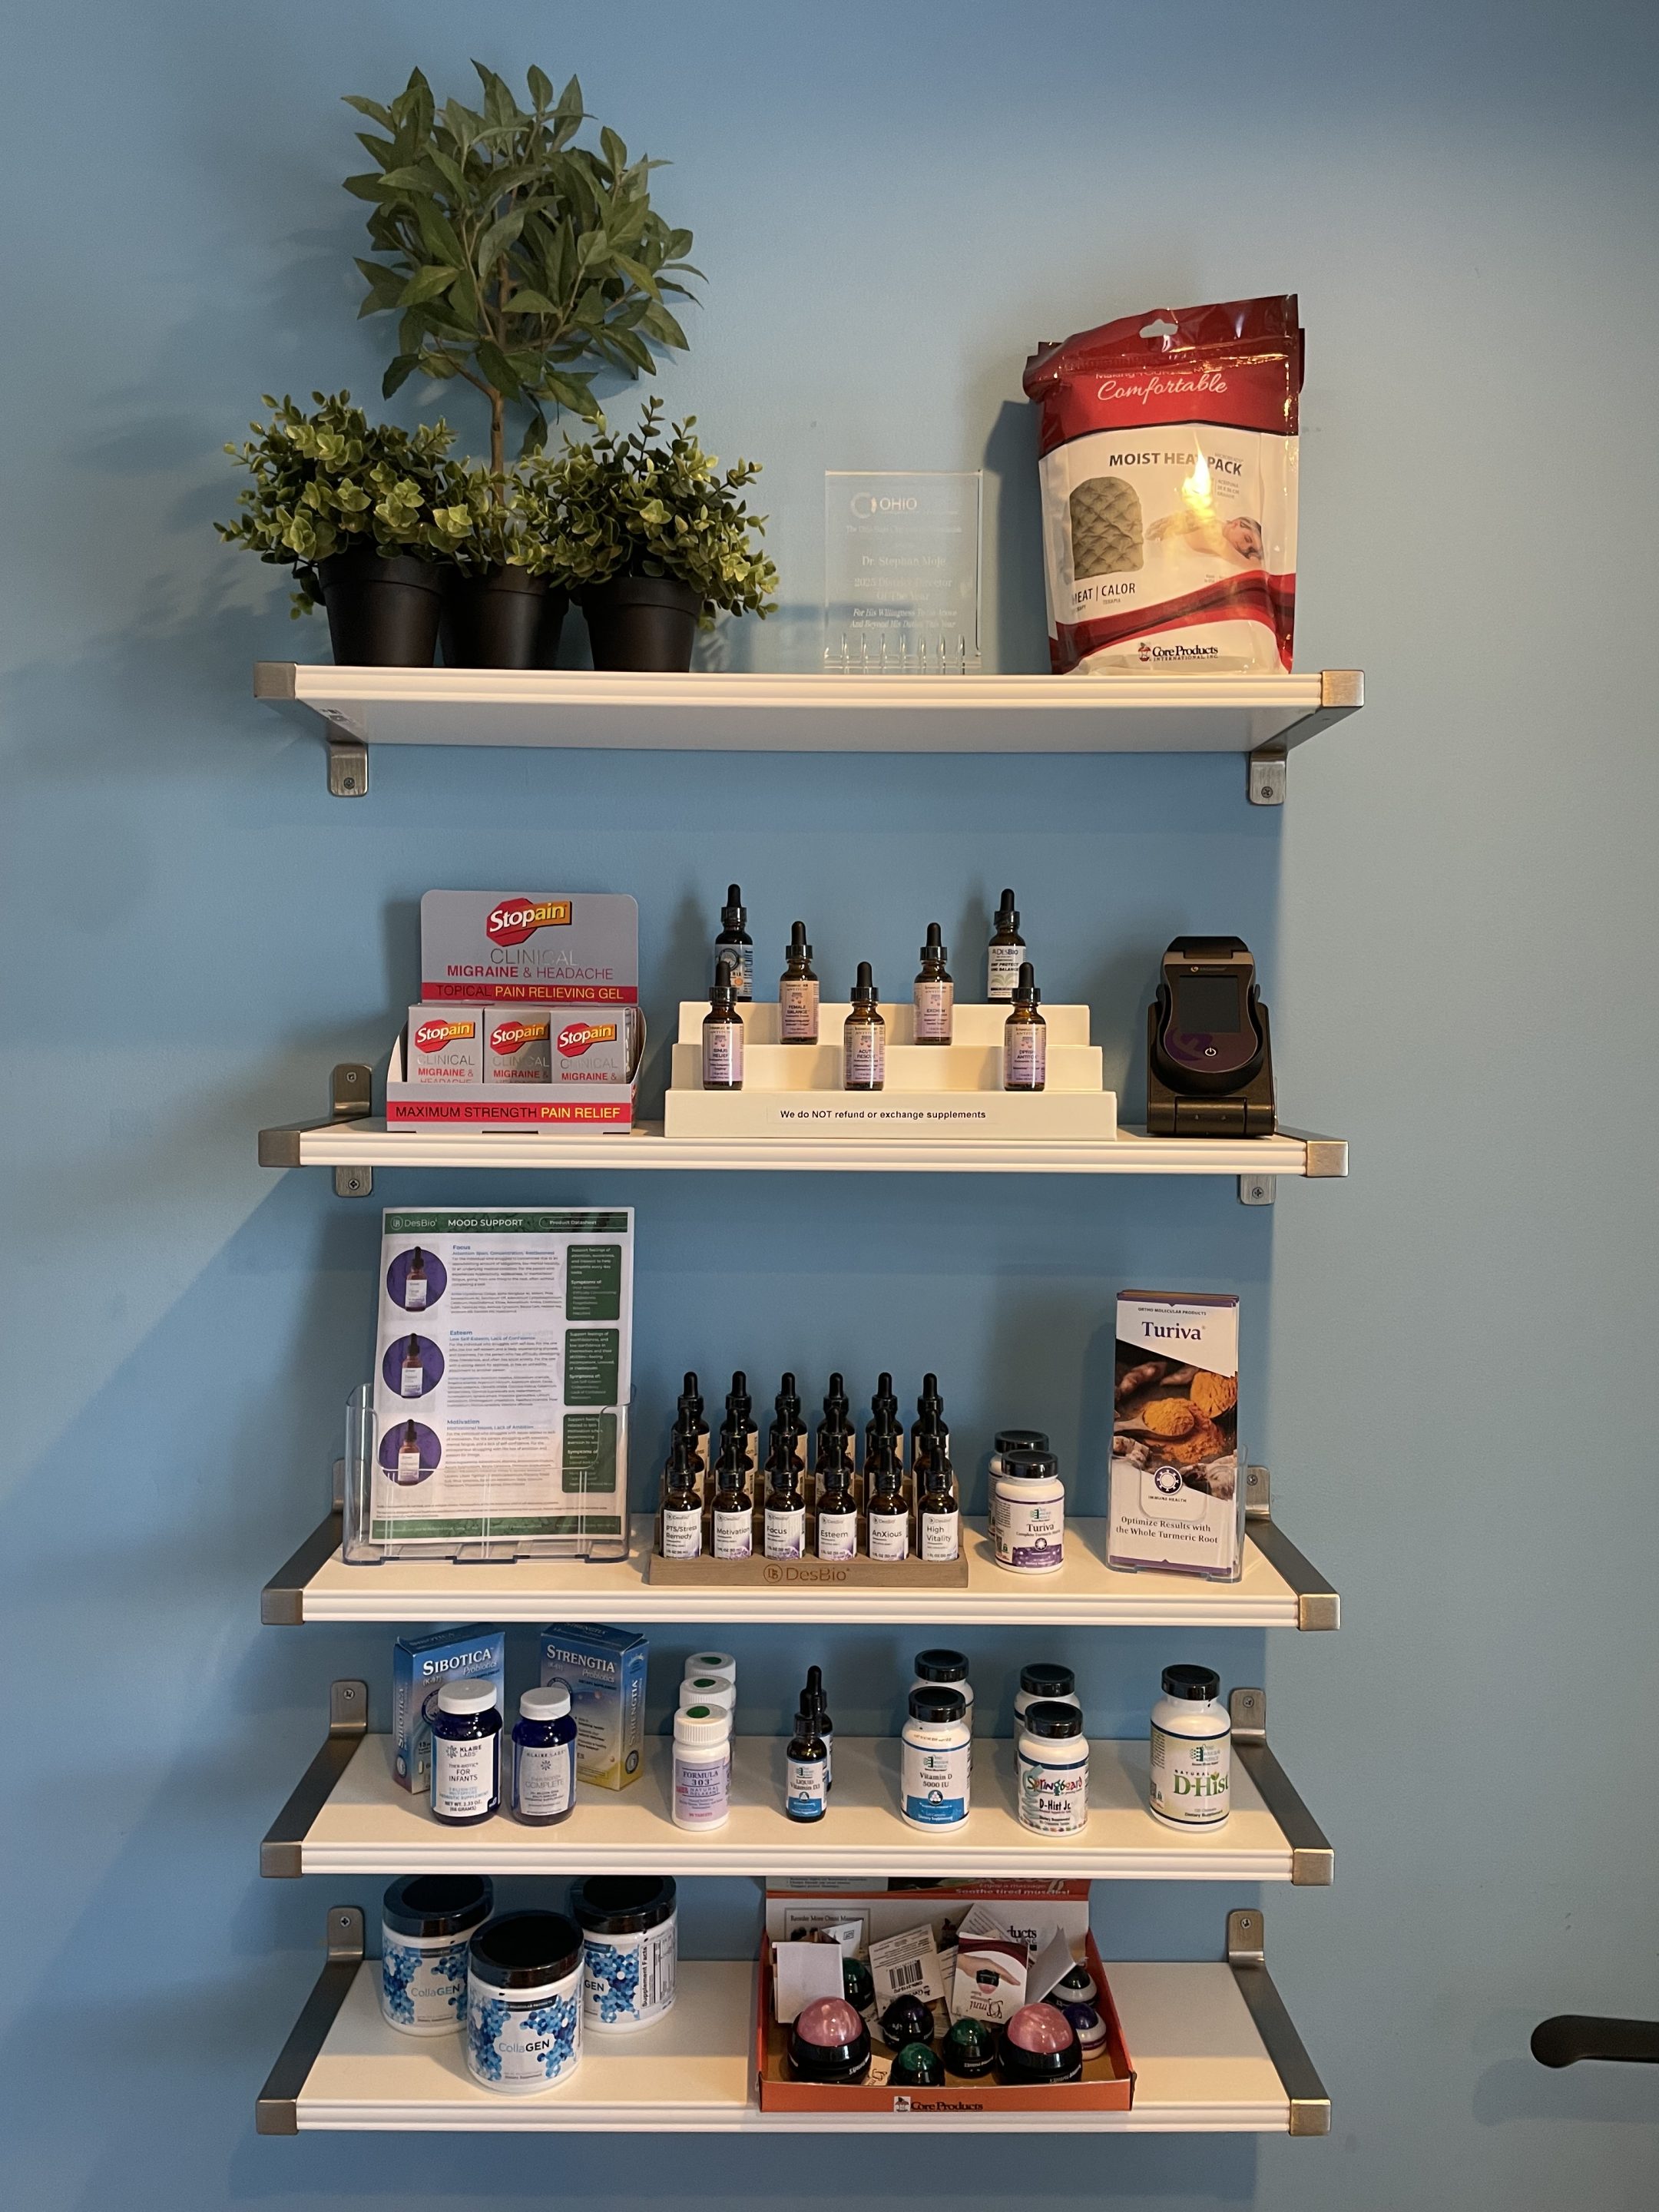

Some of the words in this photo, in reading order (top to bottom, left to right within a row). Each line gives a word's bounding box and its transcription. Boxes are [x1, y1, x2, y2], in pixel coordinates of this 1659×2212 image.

[1098, 373, 1228, 405] Comfortable
[1109, 452, 1161, 467] MOIST
[1164, 452, 1200, 465] HEA
[1207, 456, 1243, 475] PACK
[879, 498, 917, 511] OHIO
[1101, 583, 1136, 597] CALOR
[1152, 645, 1175, 657] Core
[1175, 644, 1219, 656] Products
[489, 905, 565, 932] Stopain
[490, 948, 578, 966] CLINICAL
[448, 965, 518, 978] MIGRAINE
[523, 967, 532, 979] &
[537, 967, 614, 980] HEADACHE
[437, 985, 492, 997] TOPICAL
[495, 986, 525, 998] PAIN
[529, 987, 595, 999] RELIEVING
[598, 988, 624, 999] GEL
[417, 1022, 472, 1042] Stopain
[492, 1025, 546, 1045] Stopain
[559, 1028, 613, 1048] Stopain
[417, 1054, 475, 1067] CLINICAL
[418, 1068, 465, 1077] MIGRAINE
[467, 1069, 474, 1078] &
[493, 1069, 540, 1079] MIGRAINE
[561, 1072, 608, 1081] MIGRAINE
[611, 1073, 618, 1081] &
[396, 1107, 461, 1118] MAXIMUM
[464, 1107, 538, 1118] STRENGTH
[541, 1108, 571, 1119] PAIN
[574, 1108, 621, 1119] RELIEF
[879, 1111, 924, 1121] exchange
[926, 1111, 986, 1120] supplements
[404, 1219, 435, 1227] DesBio
[448, 1219, 478, 1227] MOOD
[480, 1219, 523, 1227] SUPPORT
[1141, 1321, 1201, 1340] Turiva
[767, 1525, 787, 1535] Focus
[926, 1525, 945, 1534] High
[1026, 1523, 1055, 1532] Turiva
[1121, 1515, 1158, 1527] Optimize
[1160, 1520, 1190, 1529] Results
[1192, 1524, 1211, 1532] with
[717, 1526, 750, 1535] Motivation
[872, 1529, 902, 1538] AnXious
[1116, 1525, 1129, 1534] the
[1131, 1528, 1156, 1537] Whole
[1157, 1531, 1197, 1541] Turmeric
[1198, 1535, 1218, 1544] Root
[926, 1535, 952, 1543] Vitality
[786, 1568, 846, 1581] DesBio
[422, 1648, 492, 1676] SIBOTICA
[546, 1644, 615, 1673] STRENGTIA
[462, 1661, 498, 1676] Probiotics
[582, 1668, 615, 1683] Probiotics
[683, 1770, 719, 1779] FORMULA
[919, 1772, 946, 1780] Vitamin
[525, 1779, 565, 1788] COMPLETE
[1039, 1798, 1061, 1810] D-Hist
[411, 1983, 461, 1997] CollaGEN
[498, 2039, 550, 2053] CollaGEN
[910, 2101, 935, 2111] Core
[935, 2101, 984, 2111] Products
